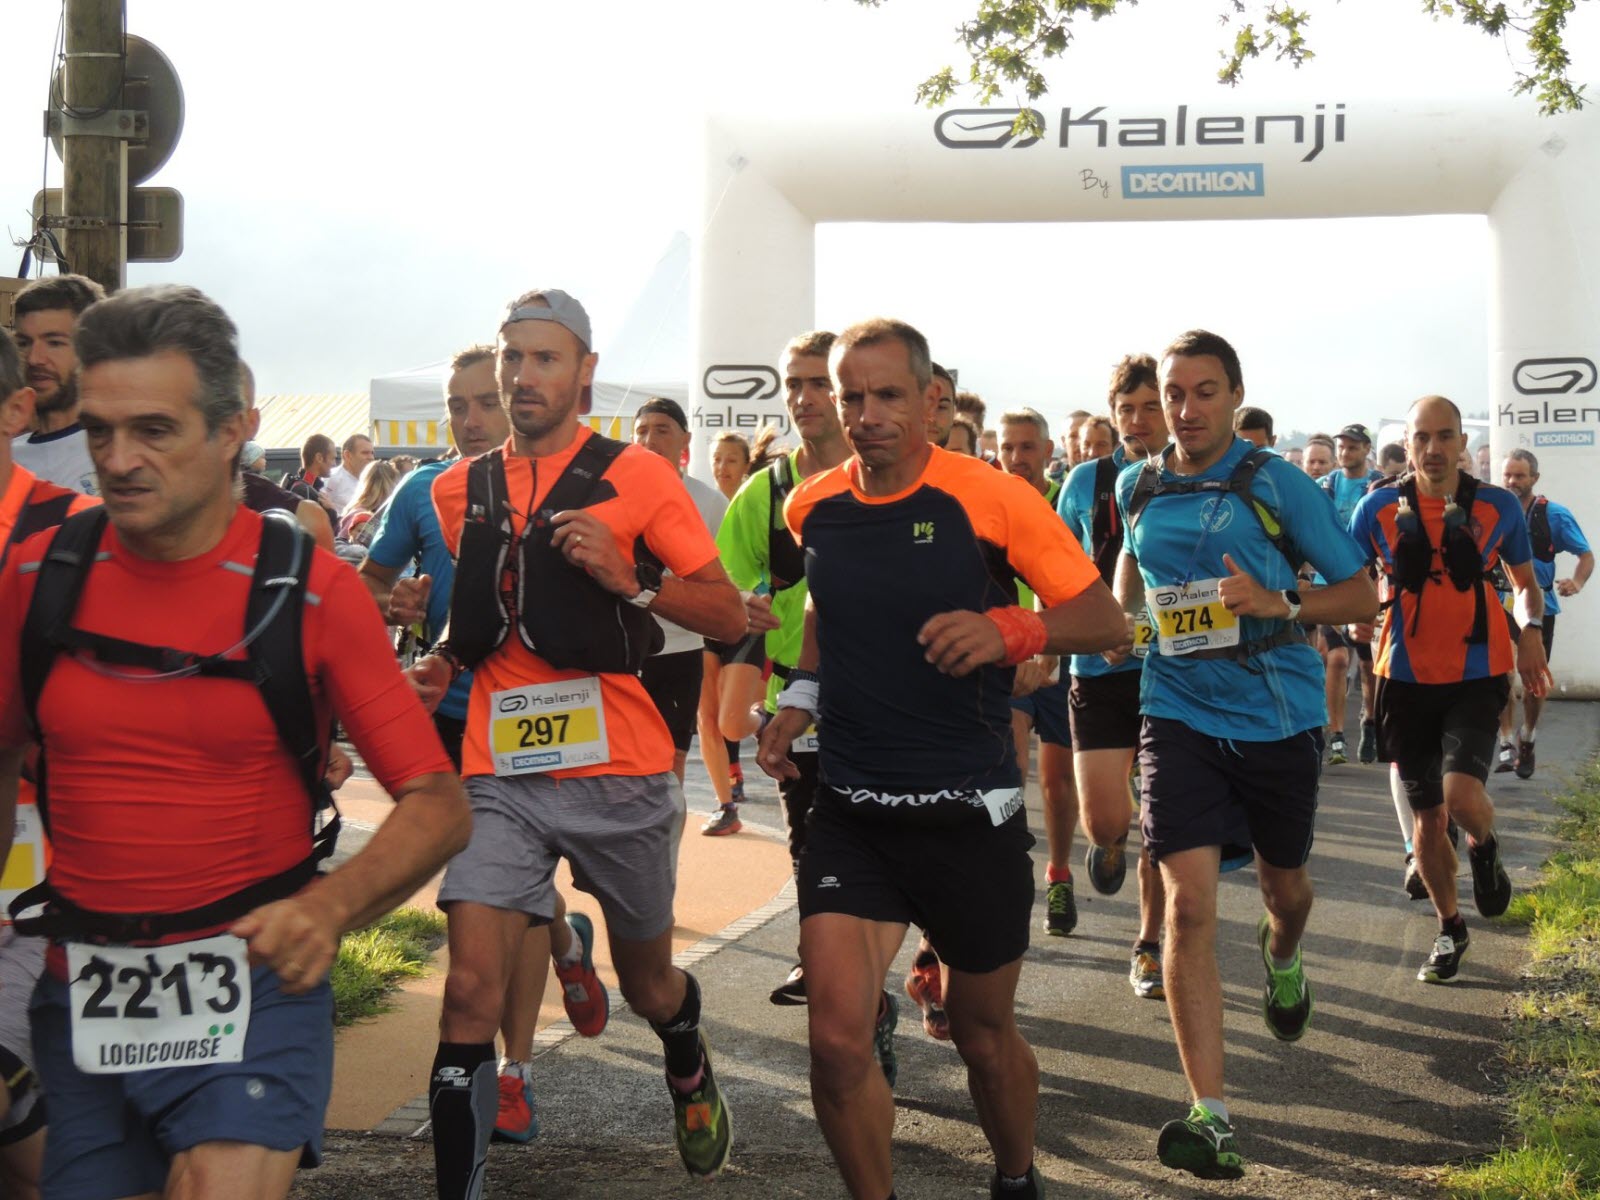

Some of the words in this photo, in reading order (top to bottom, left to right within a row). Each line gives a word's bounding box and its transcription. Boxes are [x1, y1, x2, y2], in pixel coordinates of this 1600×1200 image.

[1058, 103, 1346, 163] Kalenji
[1079, 168, 1110, 198] By
[1128, 169, 1256, 194] DECATHLON
[692, 406, 791, 436] Kalenj
[1498, 401, 1600, 426] Kalen
[1536, 432, 1593, 445] DECATHLON
[1180, 588, 1218, 601] Kalen
[1172, 606, 1213, 634] 274
[1141, 626, 1152, 643] 2
[532, 689, 590, 706] Kalenji
[517, 714, 570, 748] 297
[80, 955, 241, 1018] 2213
[101, 1037, 221, 1066] LOGICOURSE
